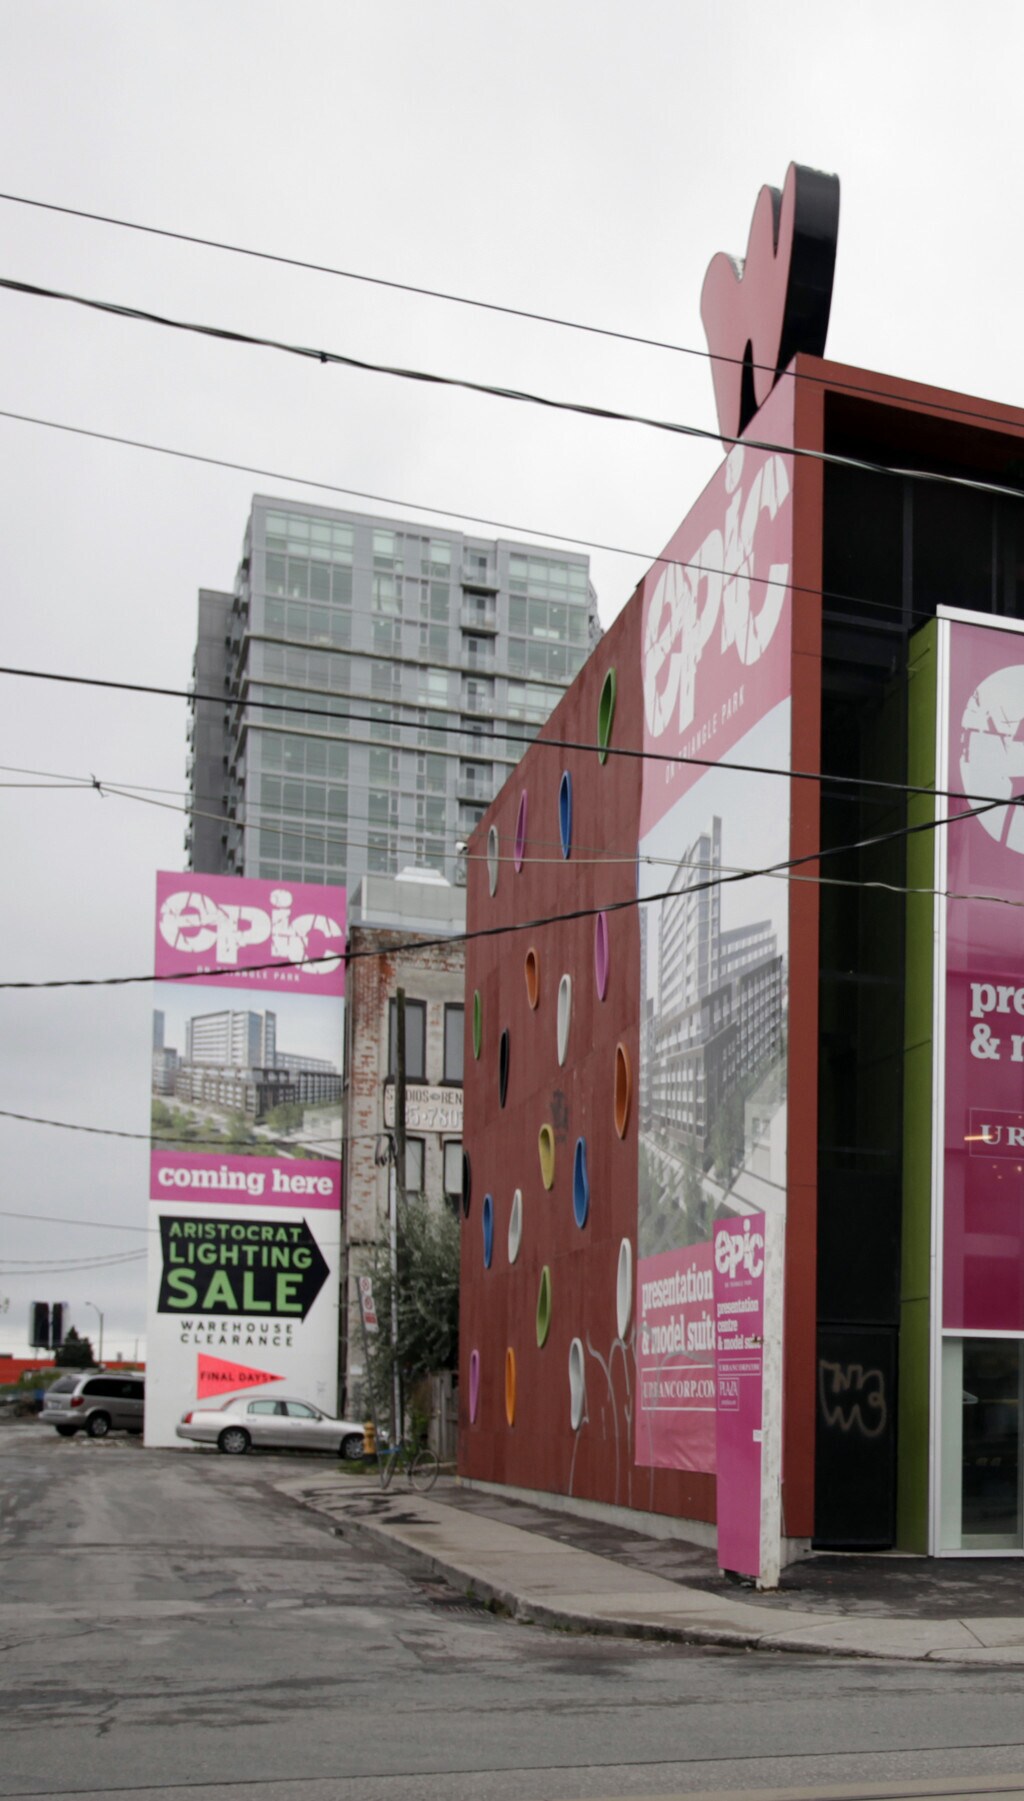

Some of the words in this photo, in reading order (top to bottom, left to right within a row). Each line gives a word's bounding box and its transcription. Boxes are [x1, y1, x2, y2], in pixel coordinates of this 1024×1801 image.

[643, 444, 789, 738] epic
[721, 684, 745, 726] PARK
[159, 889, 343, 975] epic
[970, 1023, 1001, 1060] &
[386, 1088, 429, 1104] SDIOS
[158, 1165, 265, 1196] coming
[272, 1168, 334, 1195] here
[169, 1222, 302, 1243] ARISTOCRAT
[169, 1242, 312, 1269] LIGHTING
[715, 1219, 763, 1278] epic
[167, 1267, 303, 1313] SALE
[641, 1263, 714, 1318] presentation
[717, 1296, 759, 1317] presentation
[181, 1321, 293, 1335] WAREHOUSE
[651, 1313, 685, 1353] model
[718, 1318, 738, 1332] centre
[181, 1333, 293, 1348] CLEARANCE
[723, 1333, 744, 1350] model
[200, 1372, 234, 1383] FINAL
[239, 1372, 269, 1384] DAYS
